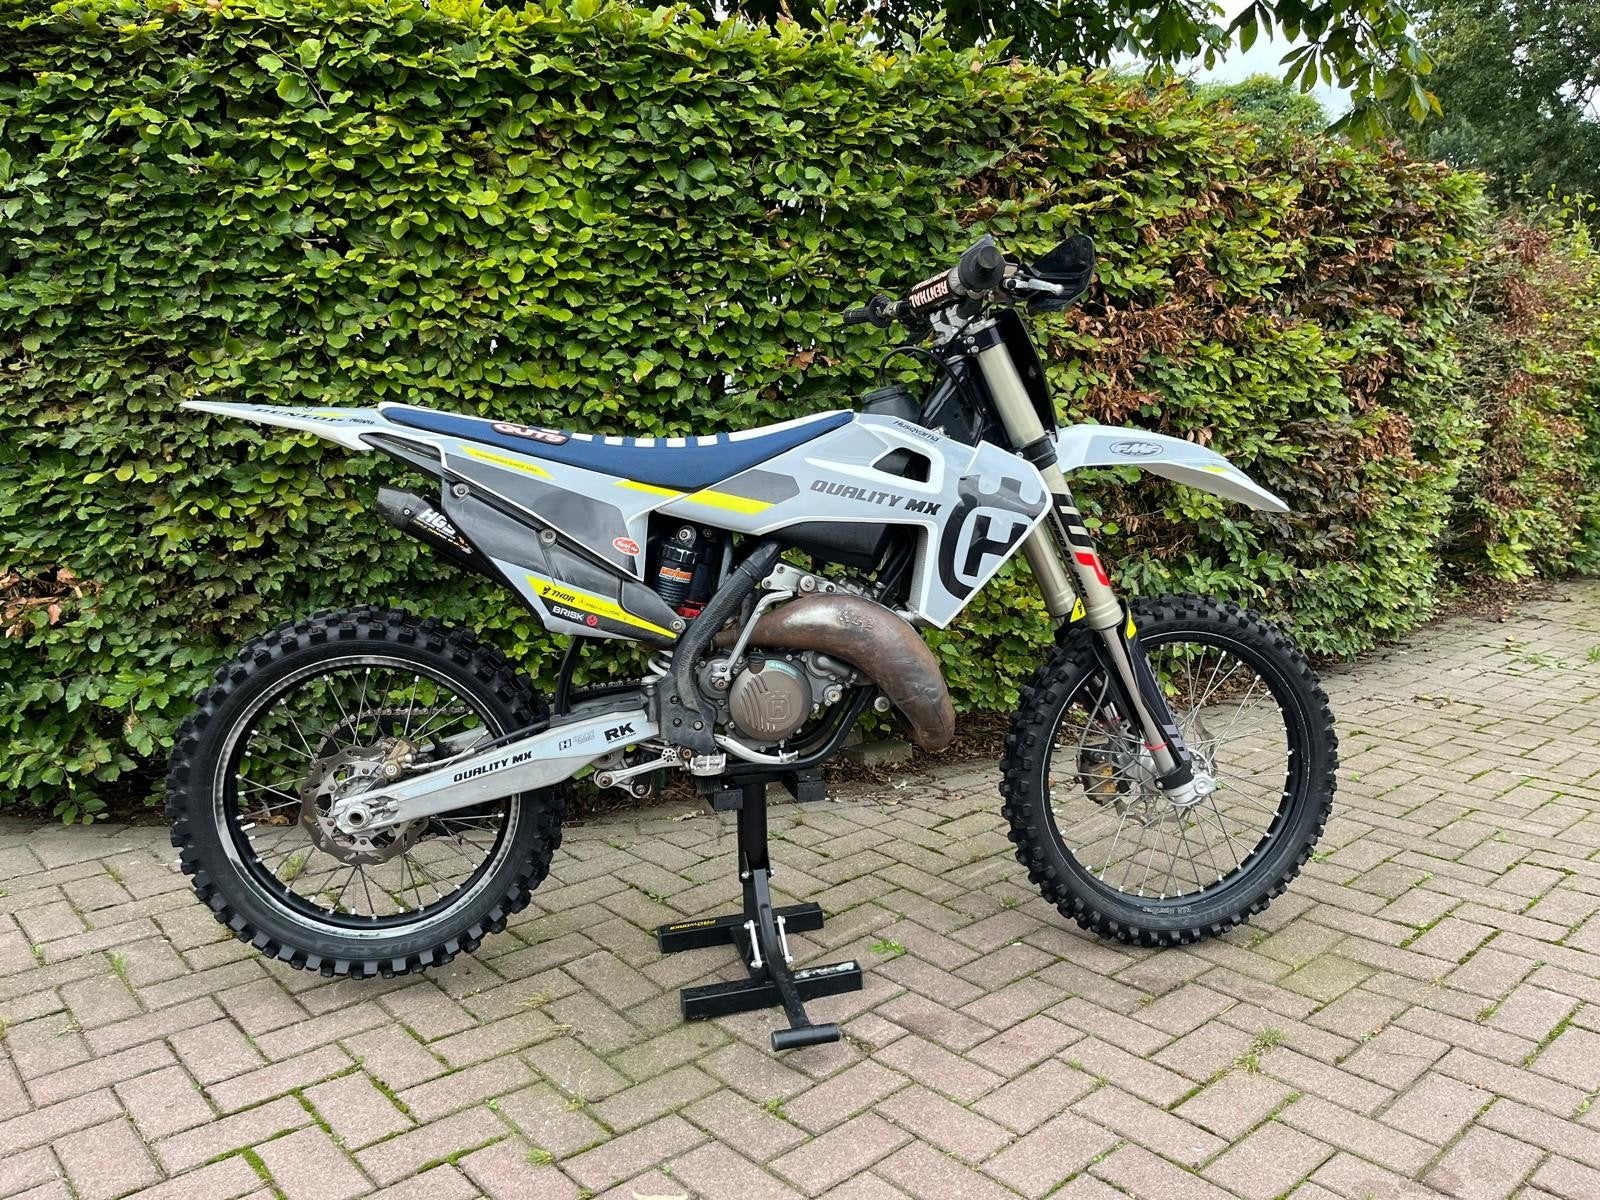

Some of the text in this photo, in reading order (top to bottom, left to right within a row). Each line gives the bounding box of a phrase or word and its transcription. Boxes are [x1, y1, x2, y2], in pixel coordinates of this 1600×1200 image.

[909, 280, 949, 308] RENTHAL
[893, 420, 940, 442] Husqvarna
[810, 480, 943, 516] QUALITY MX
[552, 590, 576, 603] THOR
[552, 605, 585, 621] BRISK
[604, 722, 635, 741] RK
[453, 750, 533, 783] QUALITY MX
